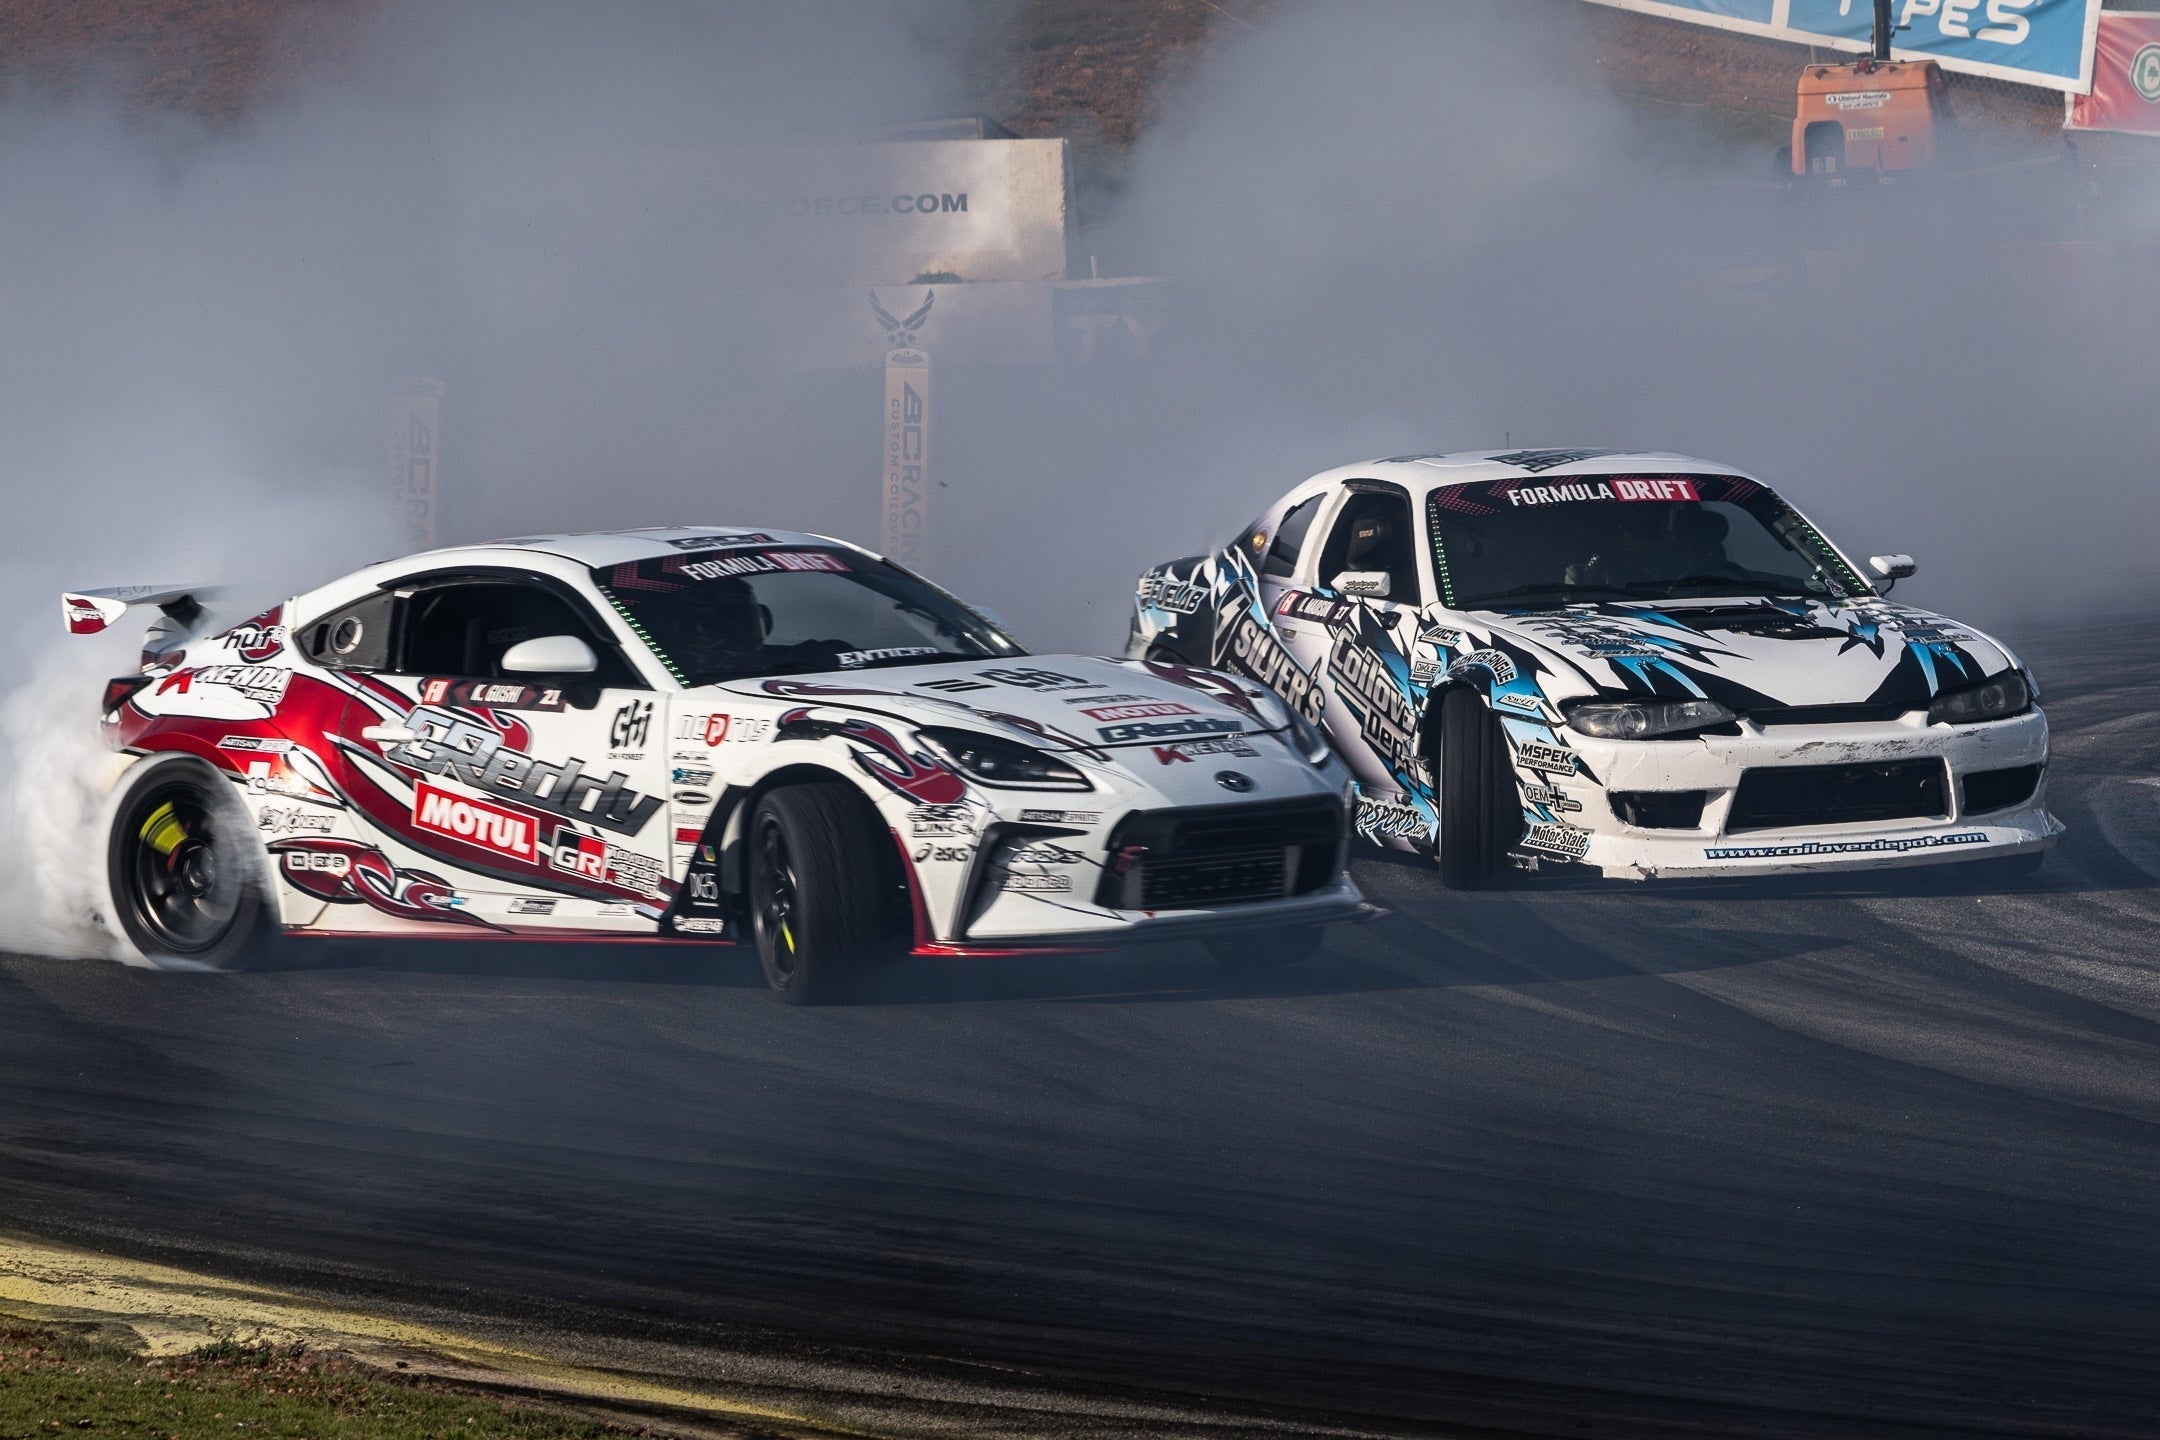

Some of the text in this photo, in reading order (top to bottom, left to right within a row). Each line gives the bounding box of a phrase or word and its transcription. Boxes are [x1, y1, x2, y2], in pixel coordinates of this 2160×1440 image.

[889, 398, 900, 561] CUSTOM COILOVER
[1507, 481, 1692, 506] FORMULA DRIFT
[679, 553, 845, 580] FORMULA DRIFT
[223, 627, 275, 649] huf
[835, 645, 939, 664] ENTICED
[197, 664, 293, 693] KENDA
[1234, 619, 1324, 727] SILVER'S
[1488, 654, 1515, 684] ANGLE
[538, 689, 562, 706] 21
[1090, 703, 1190, 720] MOTUL
[1519, 757, 1574, 774] PERFORMANCE
[1520, 742, 1574, 765] MSPEK
[419, 793, 532, 855] MOTUL
[1708, 832, 1987, 859] www.coiloverdepot.com
[554, 845, 603, 878] GR
